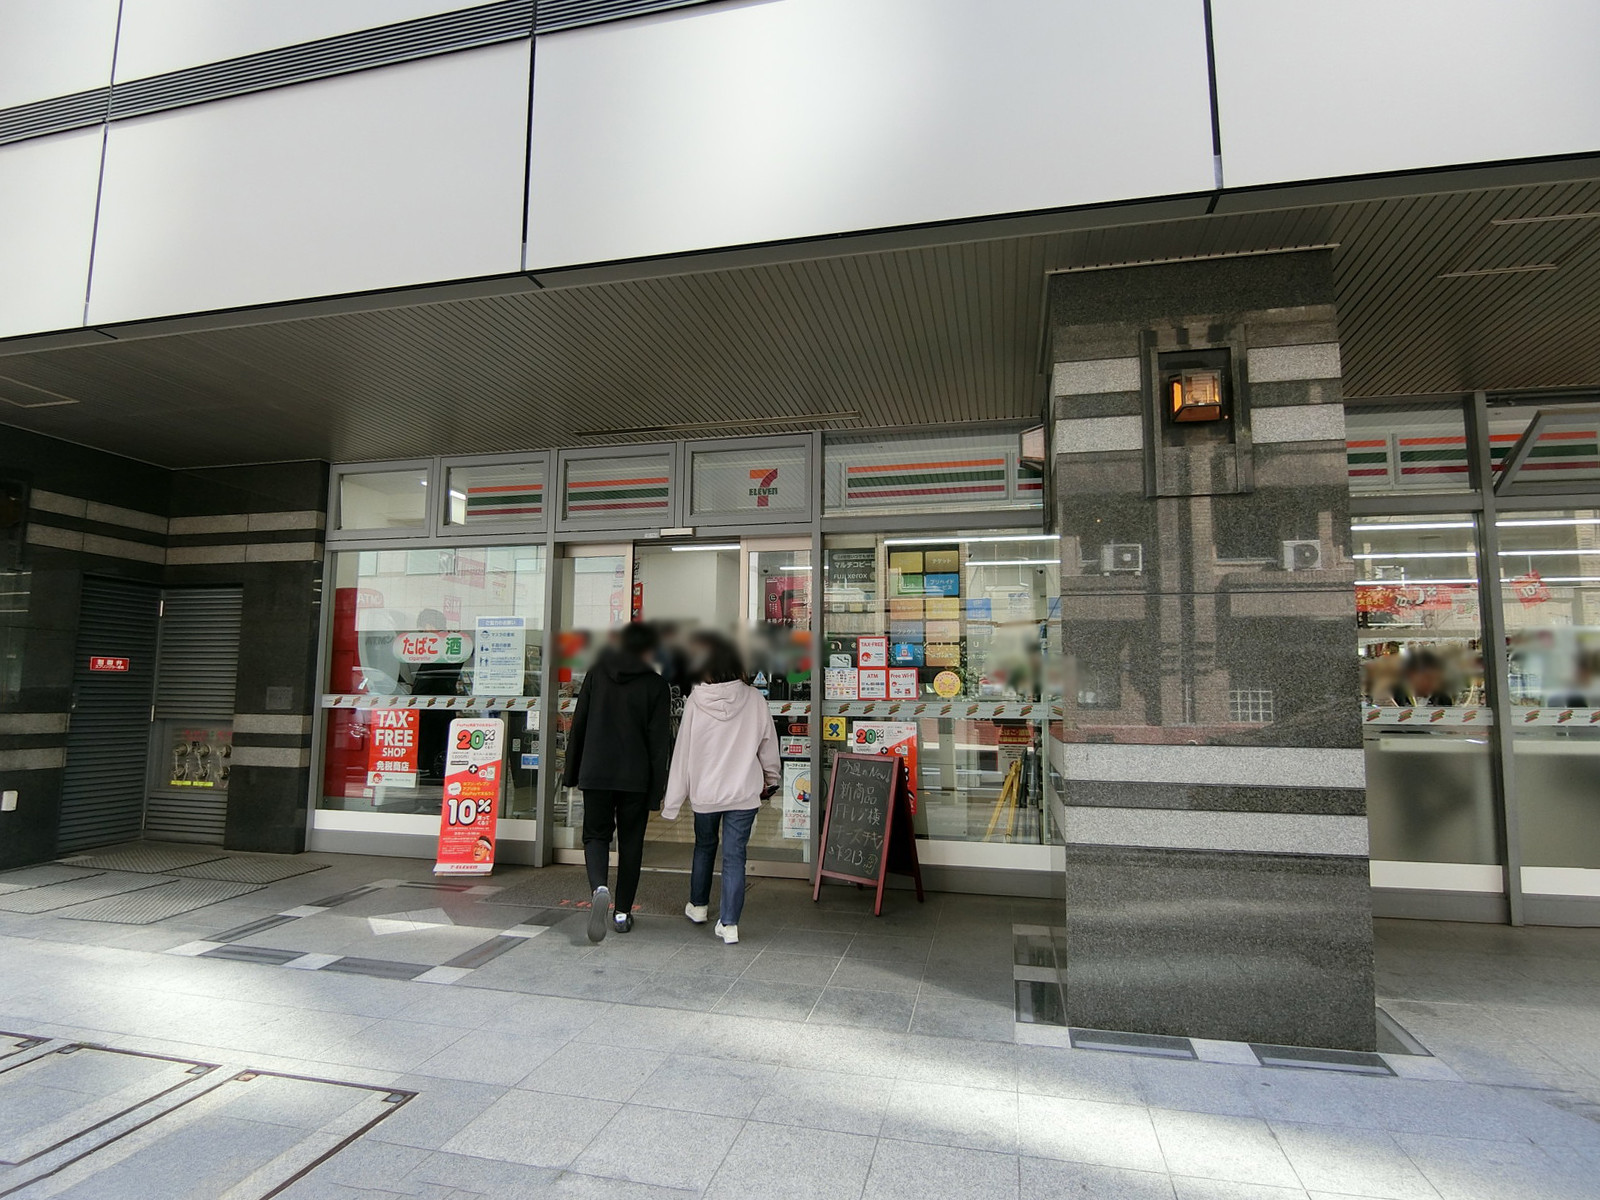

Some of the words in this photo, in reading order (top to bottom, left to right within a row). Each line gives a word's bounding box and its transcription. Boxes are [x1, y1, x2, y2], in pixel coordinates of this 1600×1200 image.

[403, 637, 438, 655] たばこ
[445, 637, 462, 655] 酒
[377, 710, 414, 728] TAX-
[375, 729, 414, 747] FREE
[382, 747, 407, 758] SHOP
[841, 781, 878, 805] 新商品
[448, 798, 492, 825] 10%
